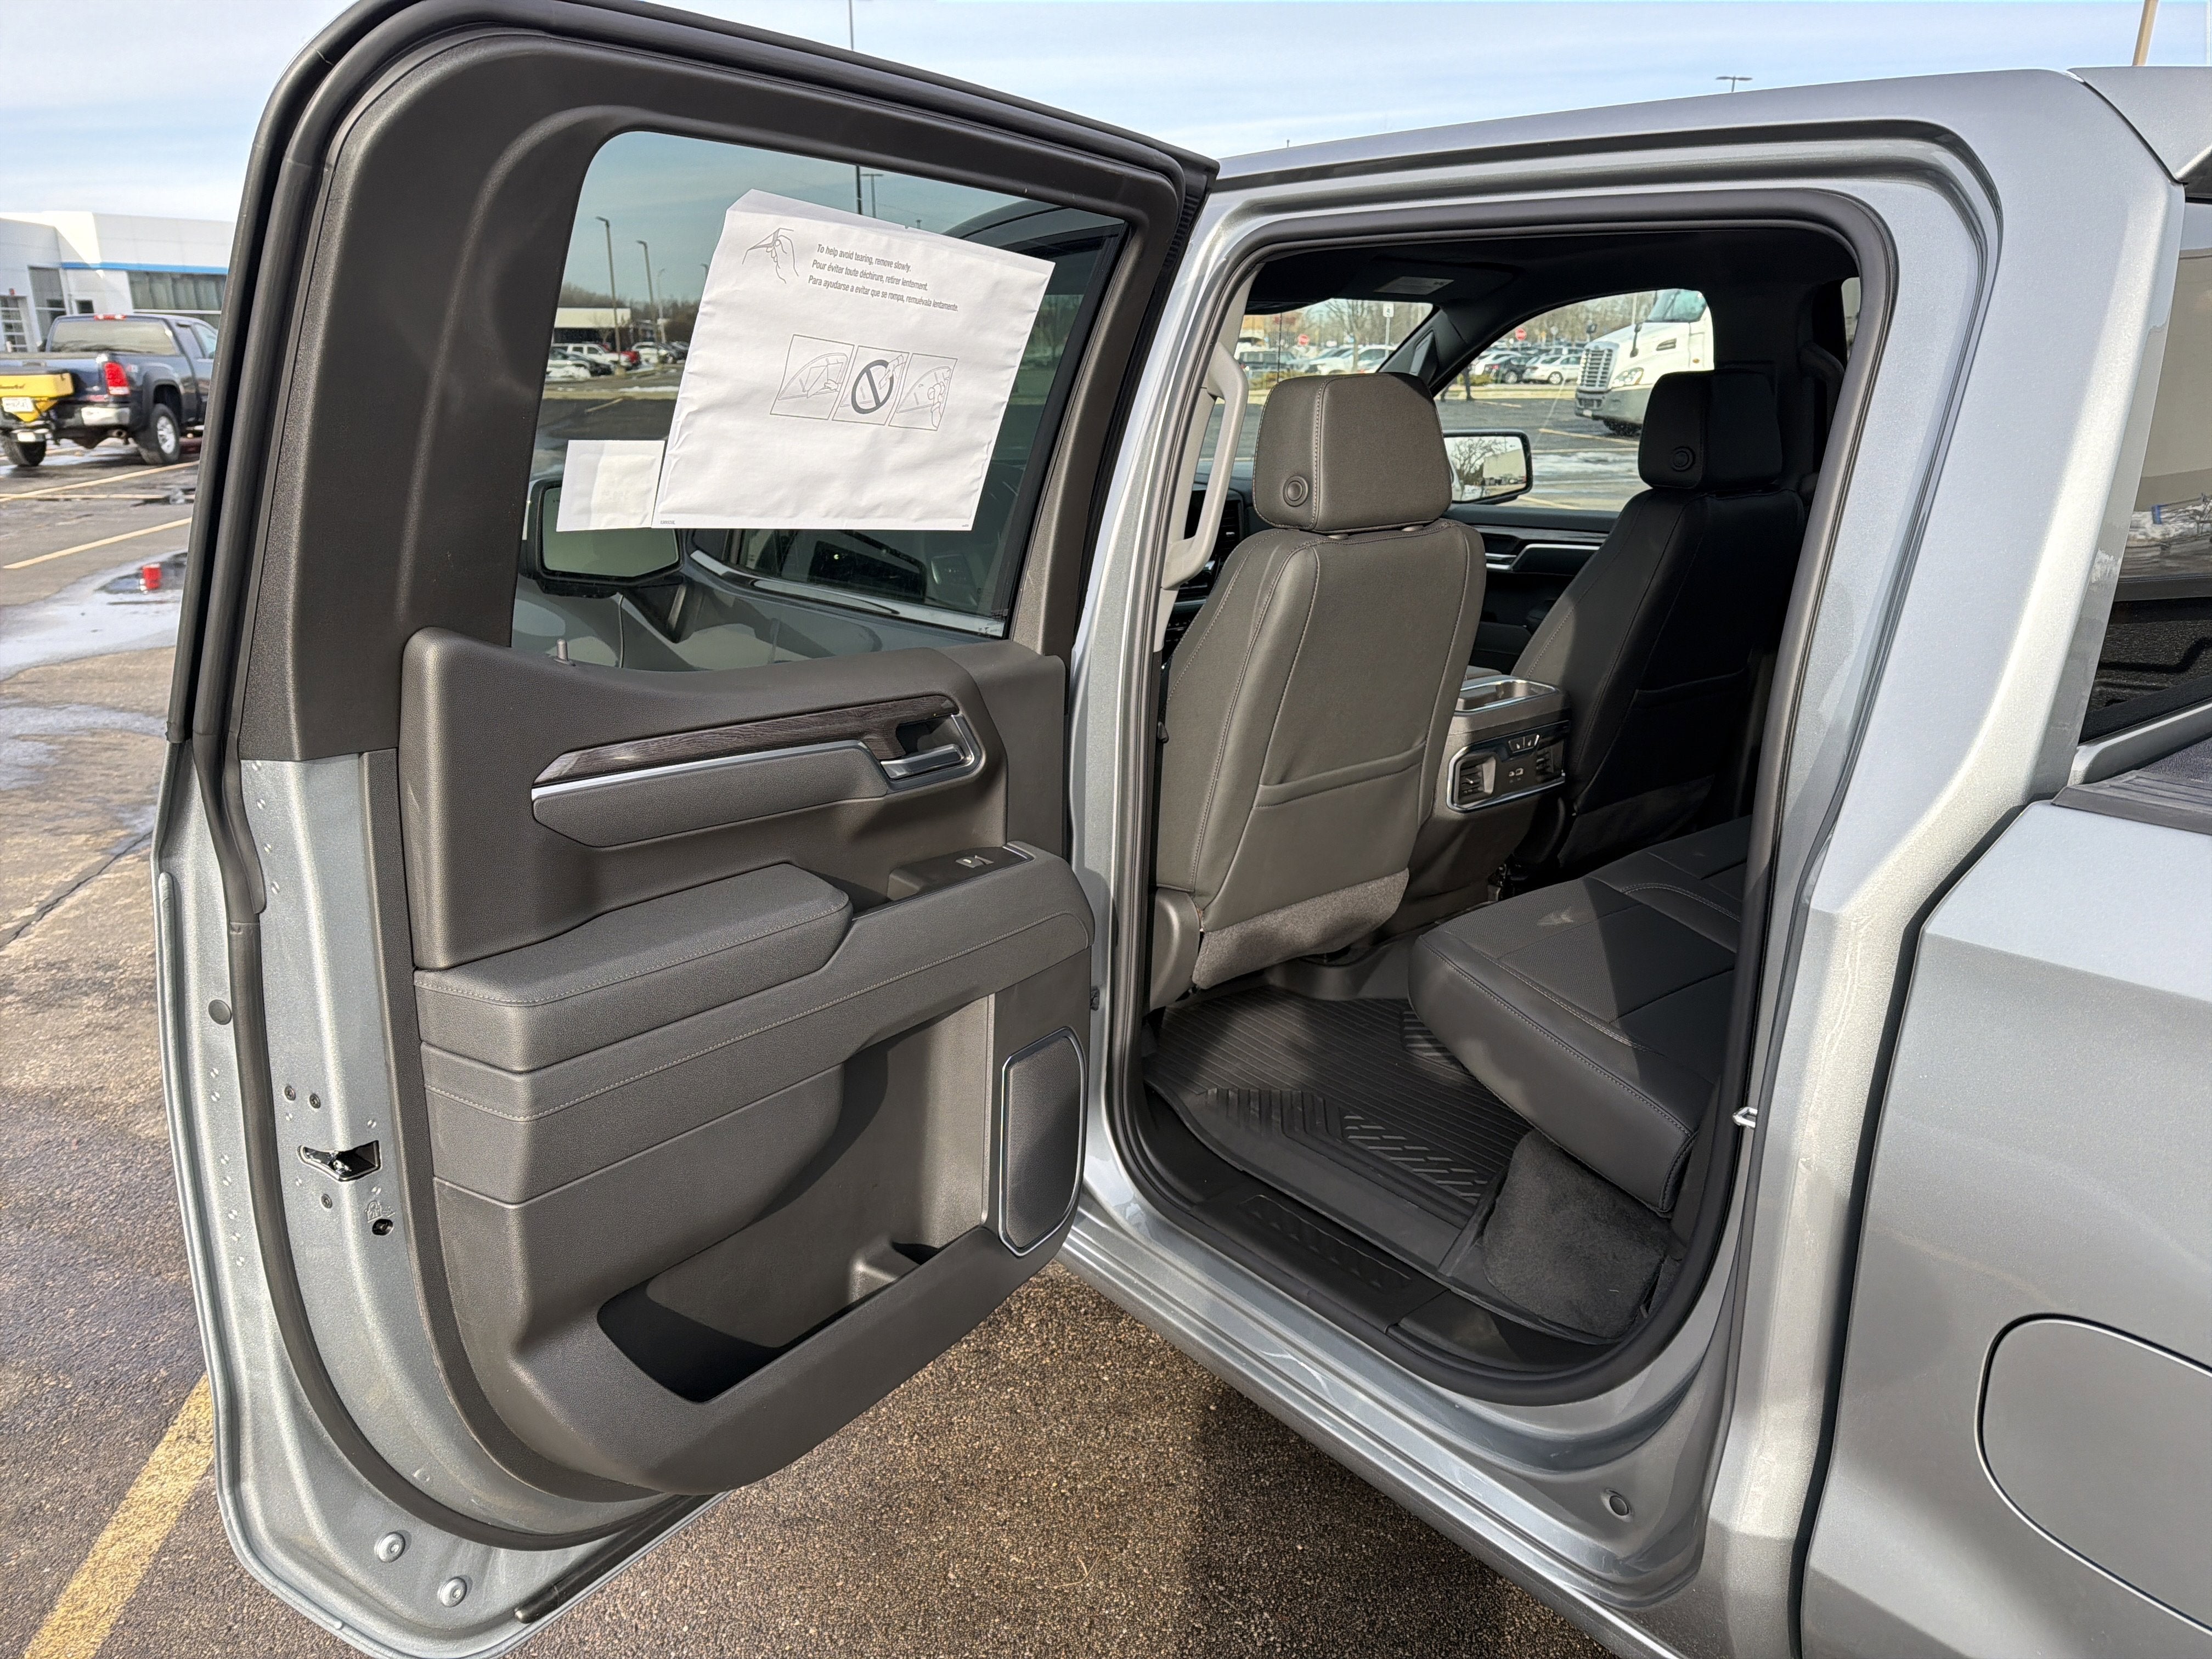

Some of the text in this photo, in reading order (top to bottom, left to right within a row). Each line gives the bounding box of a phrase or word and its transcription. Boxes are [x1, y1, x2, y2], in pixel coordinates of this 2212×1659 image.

[817, 244, 911, 273] To help avoid tearing, remove slowly.
[808, 275, 822, 285] Para
[823, 280, 849, 291] ayudarse
[855, 285, 870, 295] evitar
[871, 289, 880, 297] que
[888, 292, 905, 303] rompa,
[906, 296, 932, 307] remuévala
[812, 259, 928, 291] Pour éviter toute déchirure, retirer lentement.
